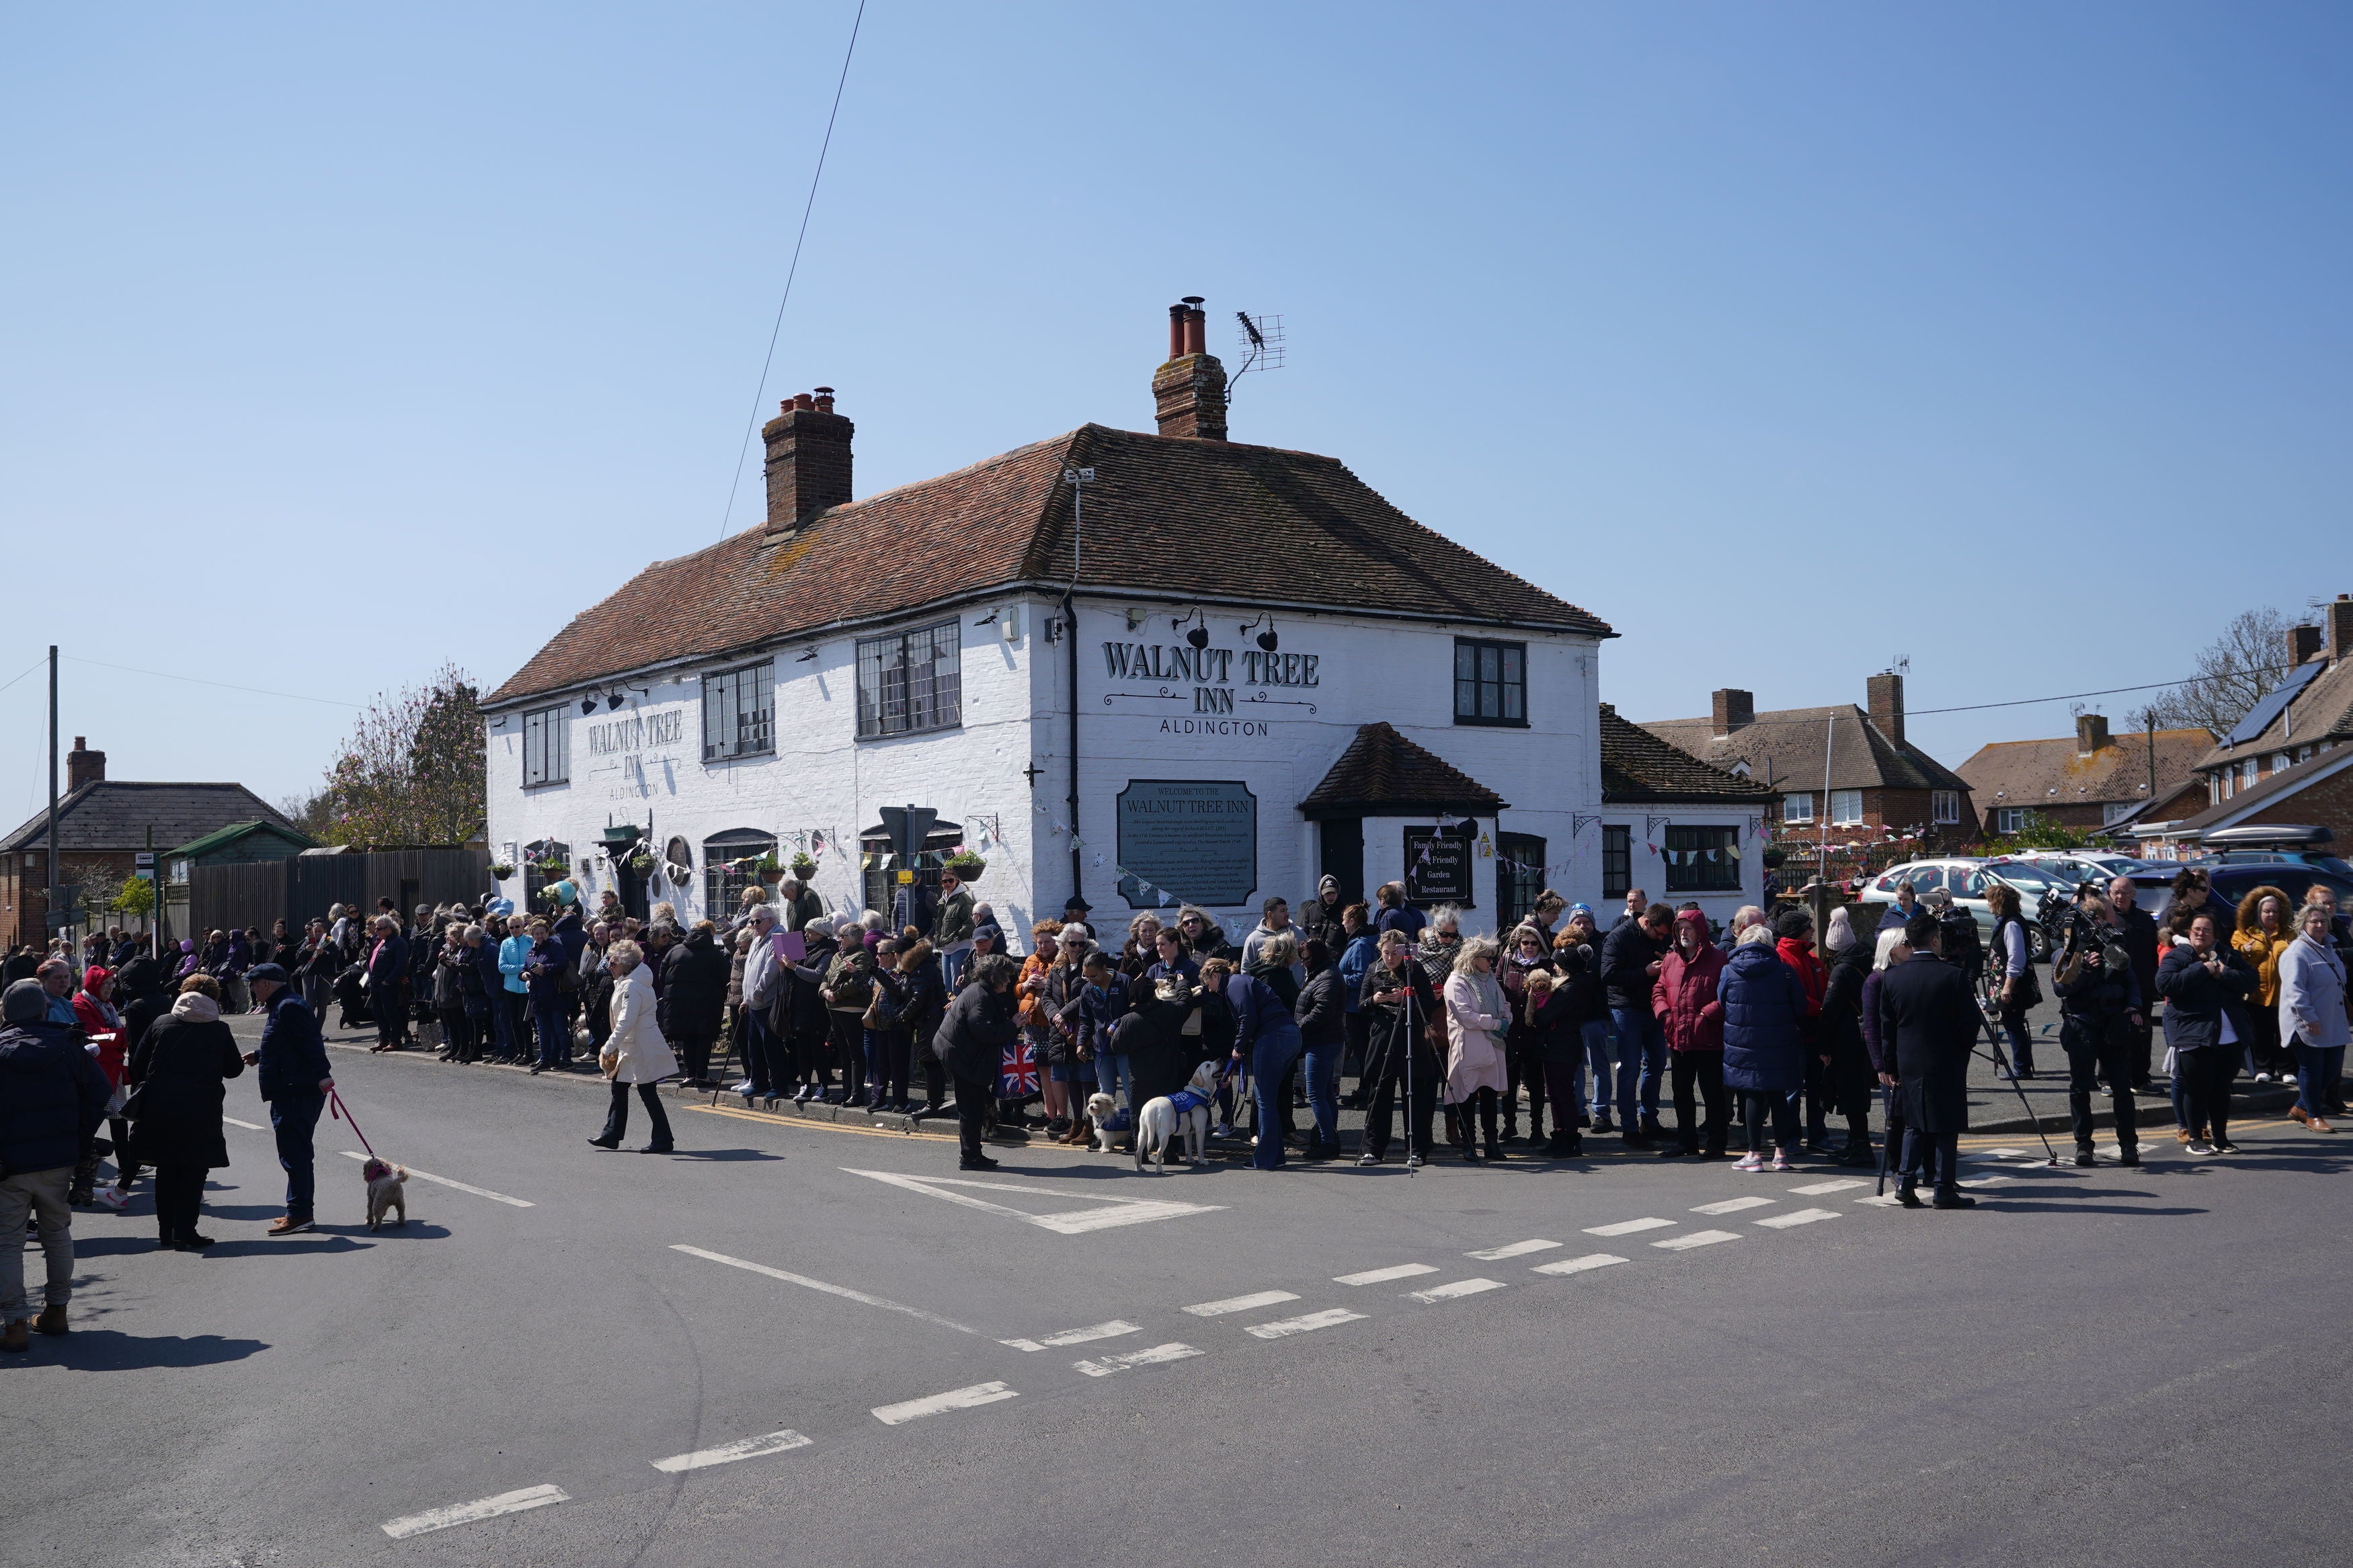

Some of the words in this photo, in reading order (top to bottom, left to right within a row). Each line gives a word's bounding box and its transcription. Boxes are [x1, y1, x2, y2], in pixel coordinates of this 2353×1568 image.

[1101, 642, 1232, 684] WALNUT
[1242, 650, 1319, 689] TREE
[1193, 686, 1235, 715] INN
[589, 717, 642, 757] WALNUT
[646, 710, 682, 748] TREE
[1160, 719, 1267, 737] ALDINGTON
[624, 753, 643, 780] INN
[610, 783, 658, 801] ALDINGTON
[1158, 787, 1193, 796] WELCOME
[1127, 800, 1185, 813] WALNUT
[1188, 800, 1223, 813] TREE
[1227, 800, 1248, 813] INN
[1414, 841, 1435, 851] Family
[1437, 841, 1463, 851] Friendly
[1432, 856, 1459, 865] Friendly
